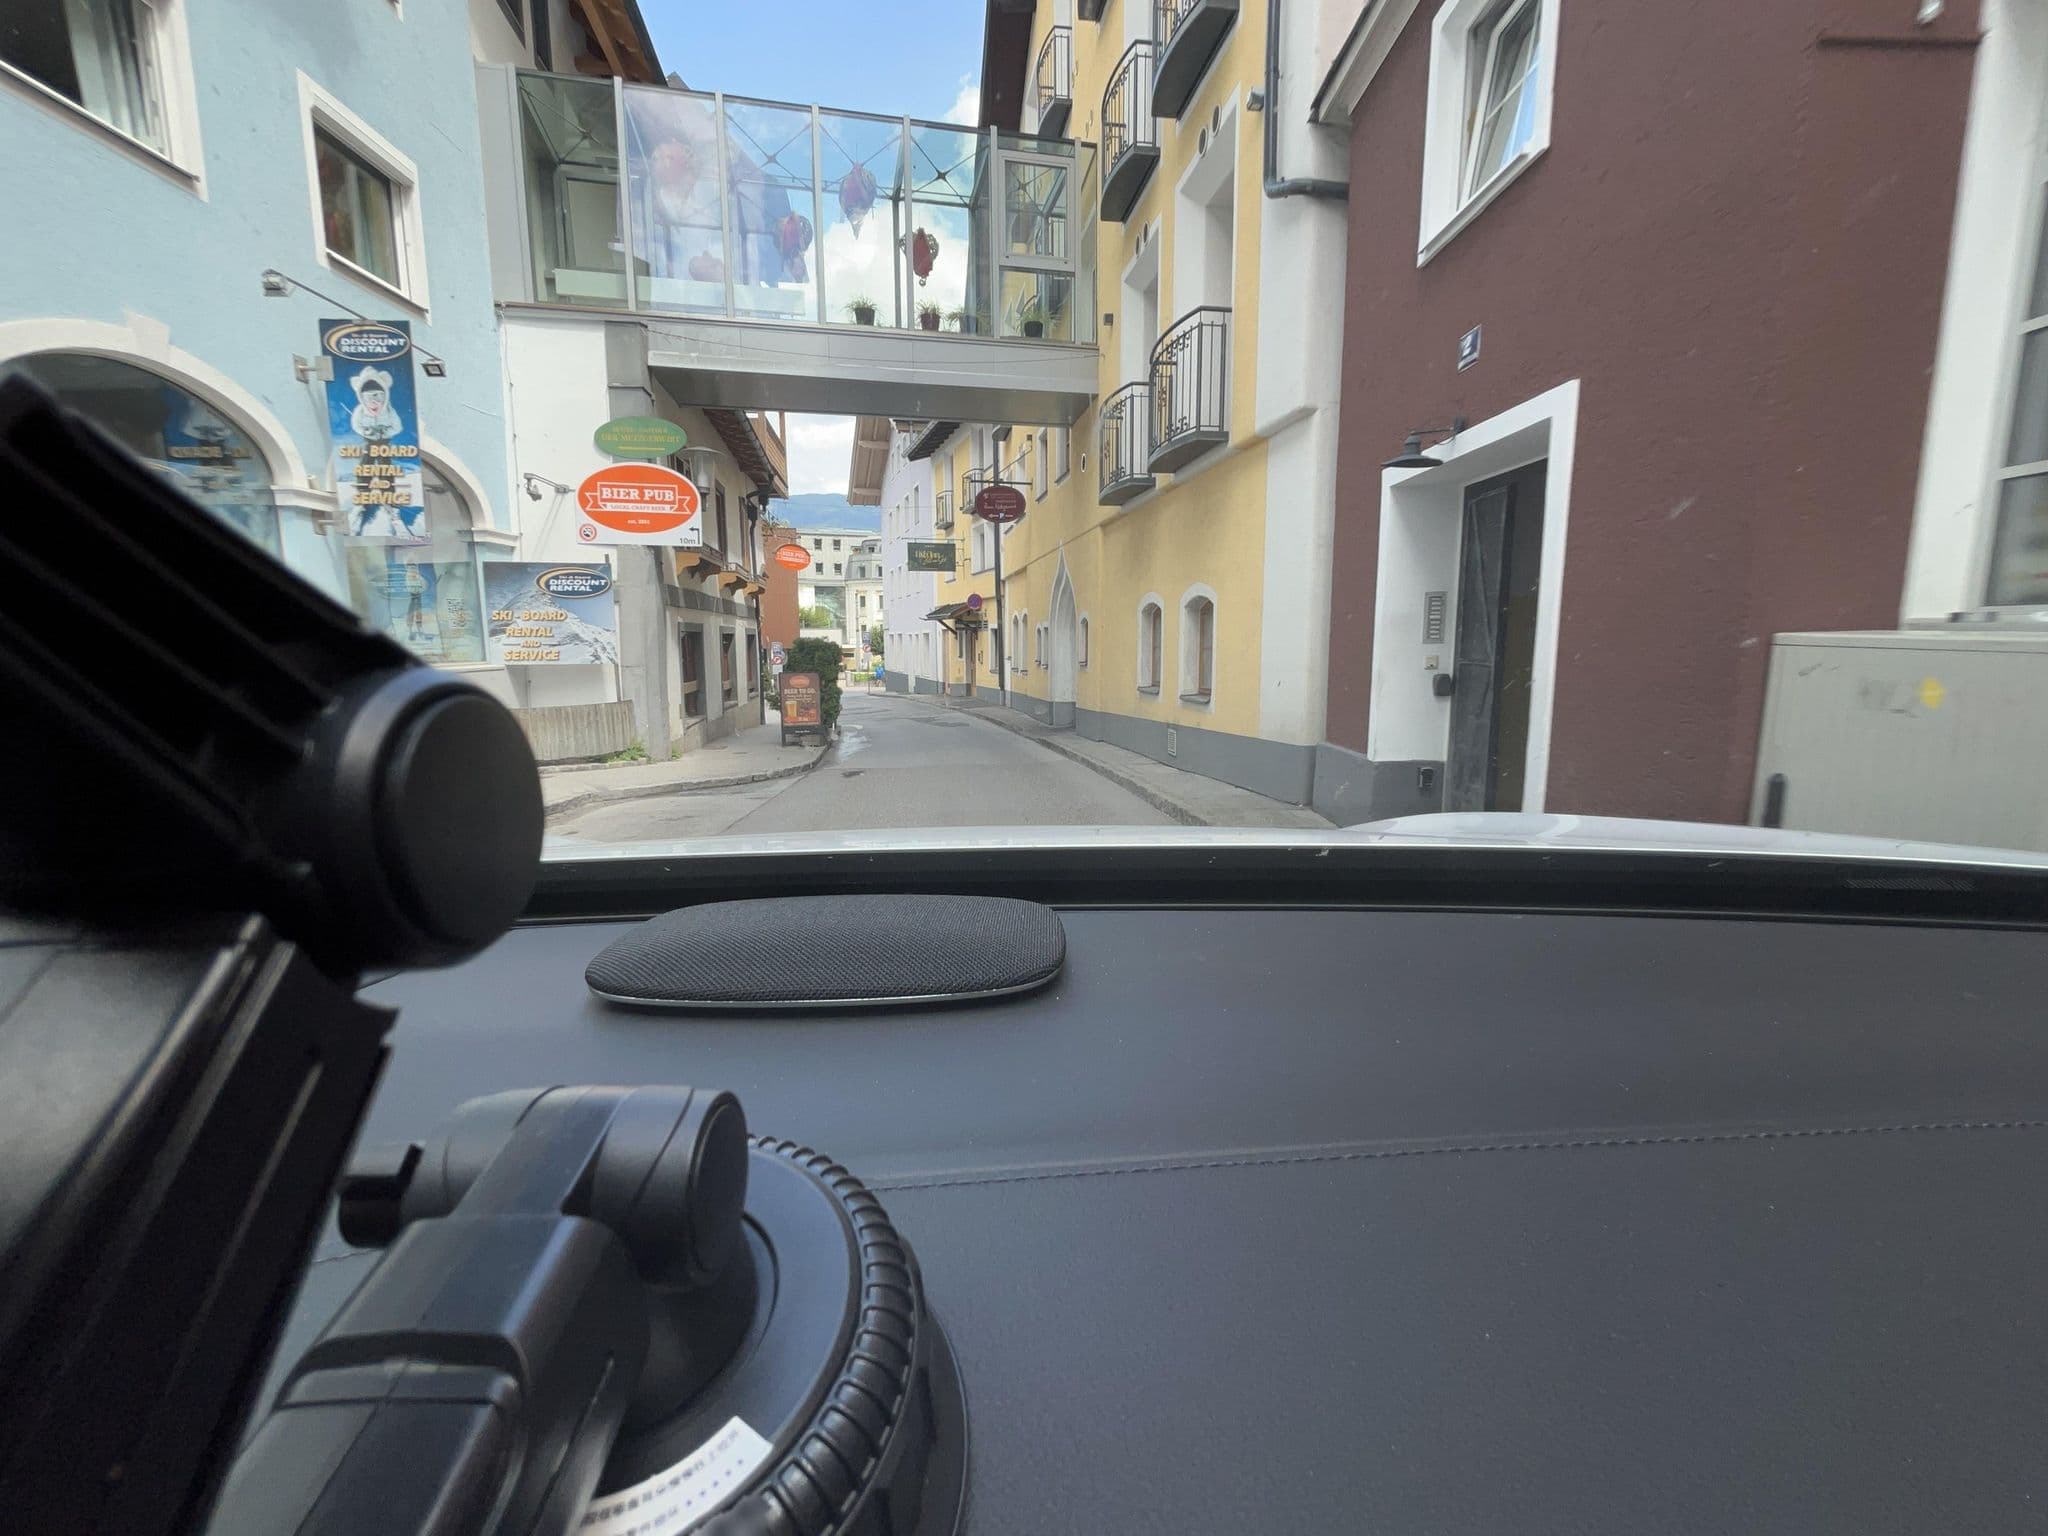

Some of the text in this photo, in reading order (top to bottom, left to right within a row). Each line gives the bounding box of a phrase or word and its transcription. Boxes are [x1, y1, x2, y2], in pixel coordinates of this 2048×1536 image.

[341, 338, 406, 346] DISCOUNT
[339, 446, 360, 457] SKI
[369, 445, 418, 457] BOARD
[354, 465, 404, 476] RENTAL
[352, 492, 411, 504] SERVICE
[601, 487, 675, 501] BIER PUB
[679, 537, 697, 545] 10m
[492, 610, 513, 621] SKI
[522, 611, 568, 621] BOARD
[505, 627, 554, 637] RENTAL
[504, 650, 560, 661] SERVICE
